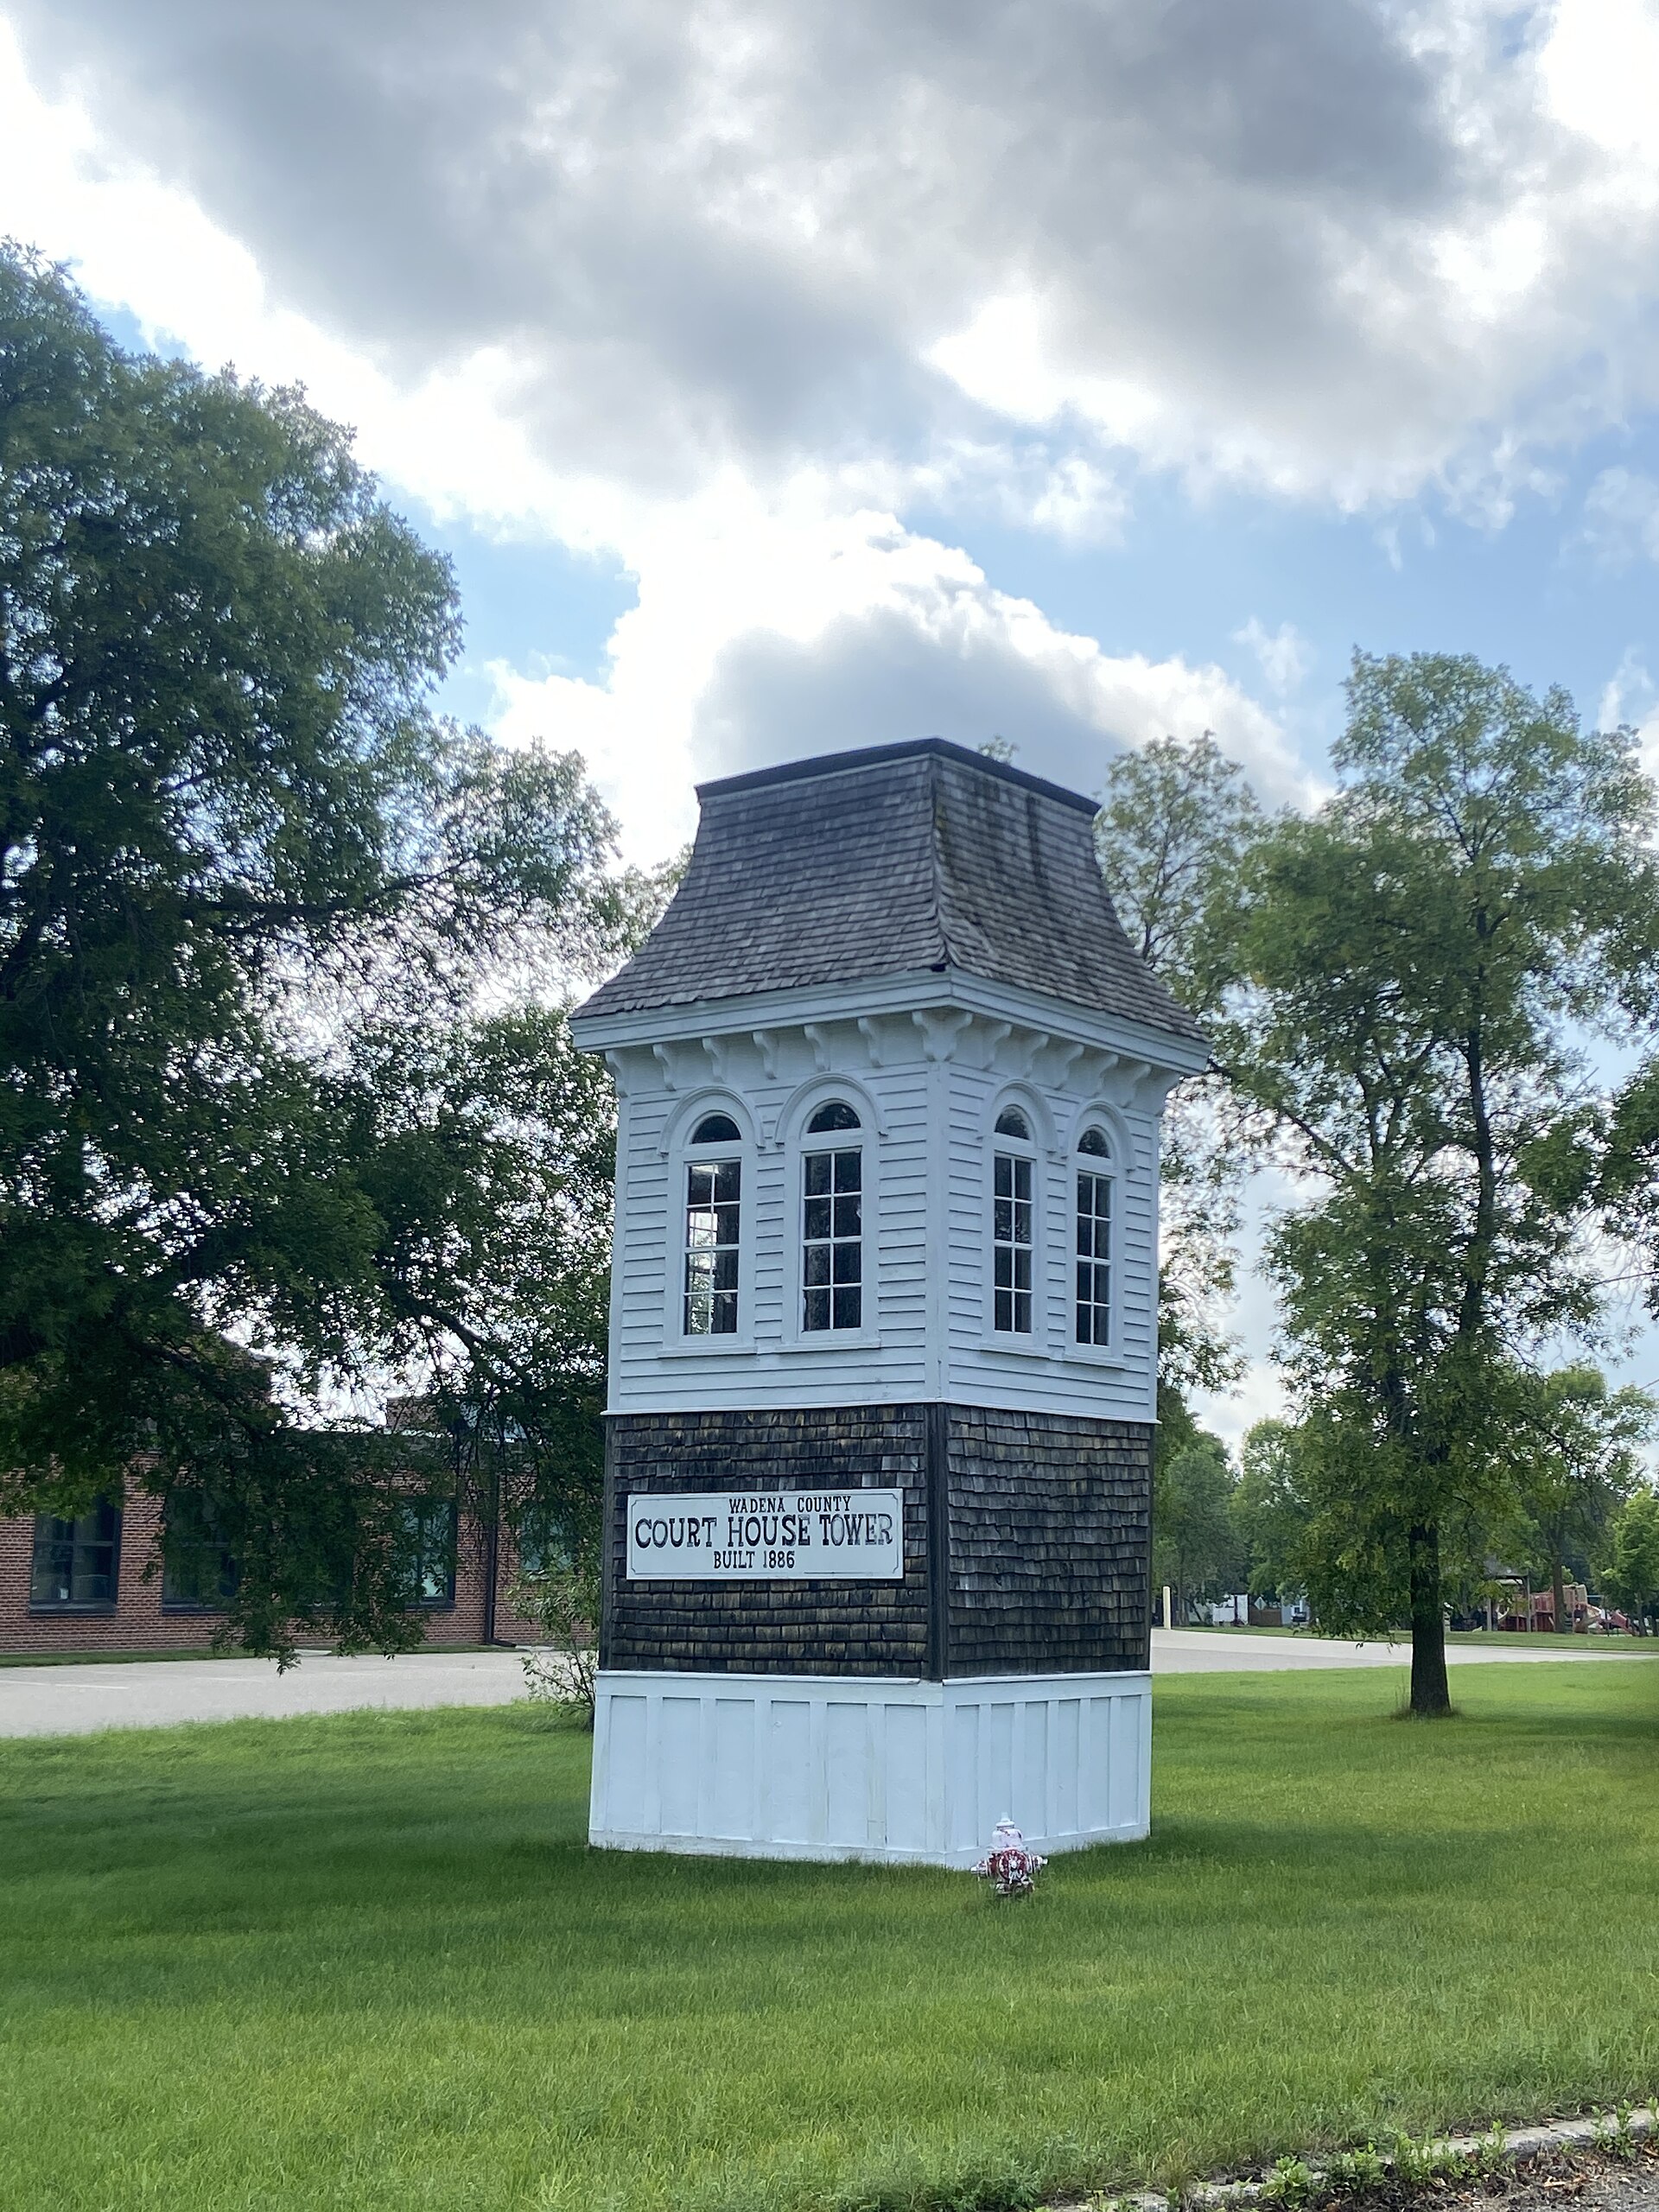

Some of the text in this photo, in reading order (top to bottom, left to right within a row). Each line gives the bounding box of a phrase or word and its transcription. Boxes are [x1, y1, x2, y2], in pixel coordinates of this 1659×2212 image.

[728, 1496, 851, 1513] WADENA COUNTY
[635, 1513, 893, 1548] COURT HOUSE TOWER
[714, 1550, 795, 1569] BUILT 1886
